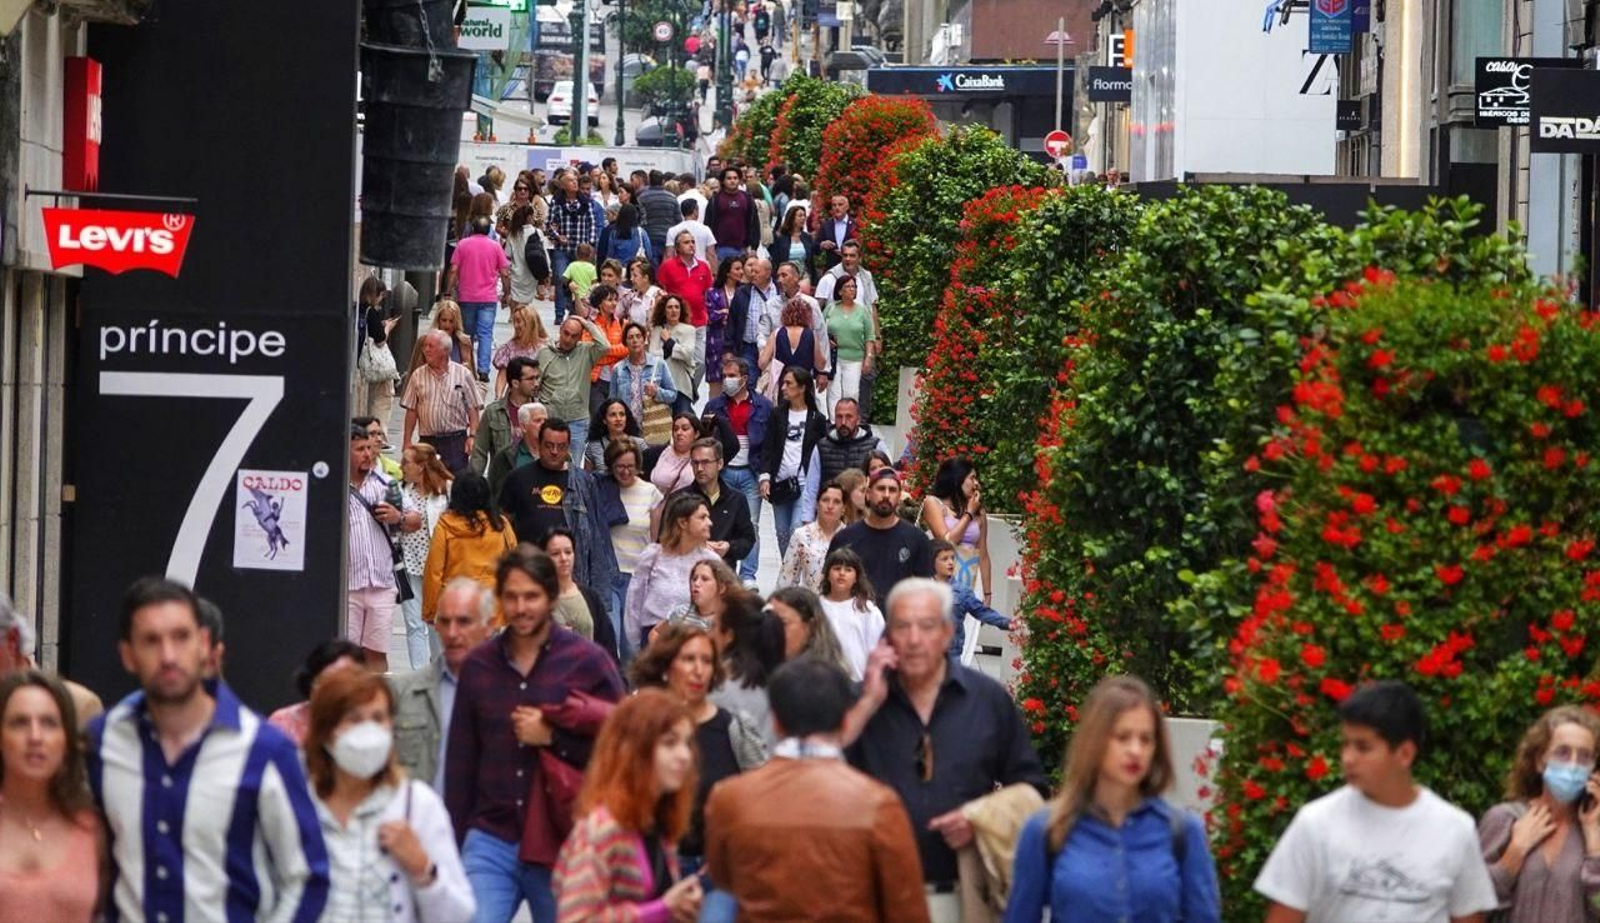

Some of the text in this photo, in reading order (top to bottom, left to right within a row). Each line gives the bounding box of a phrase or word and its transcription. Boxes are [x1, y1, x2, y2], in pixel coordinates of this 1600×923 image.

[461, 24, 502, 38] world
[955, 73, 1005, 88] CaixaBank
[100, 319, 286, 364] príncipe
[99, 371, 285, 592] 7
[243, 475, 303, 492] CALDO
